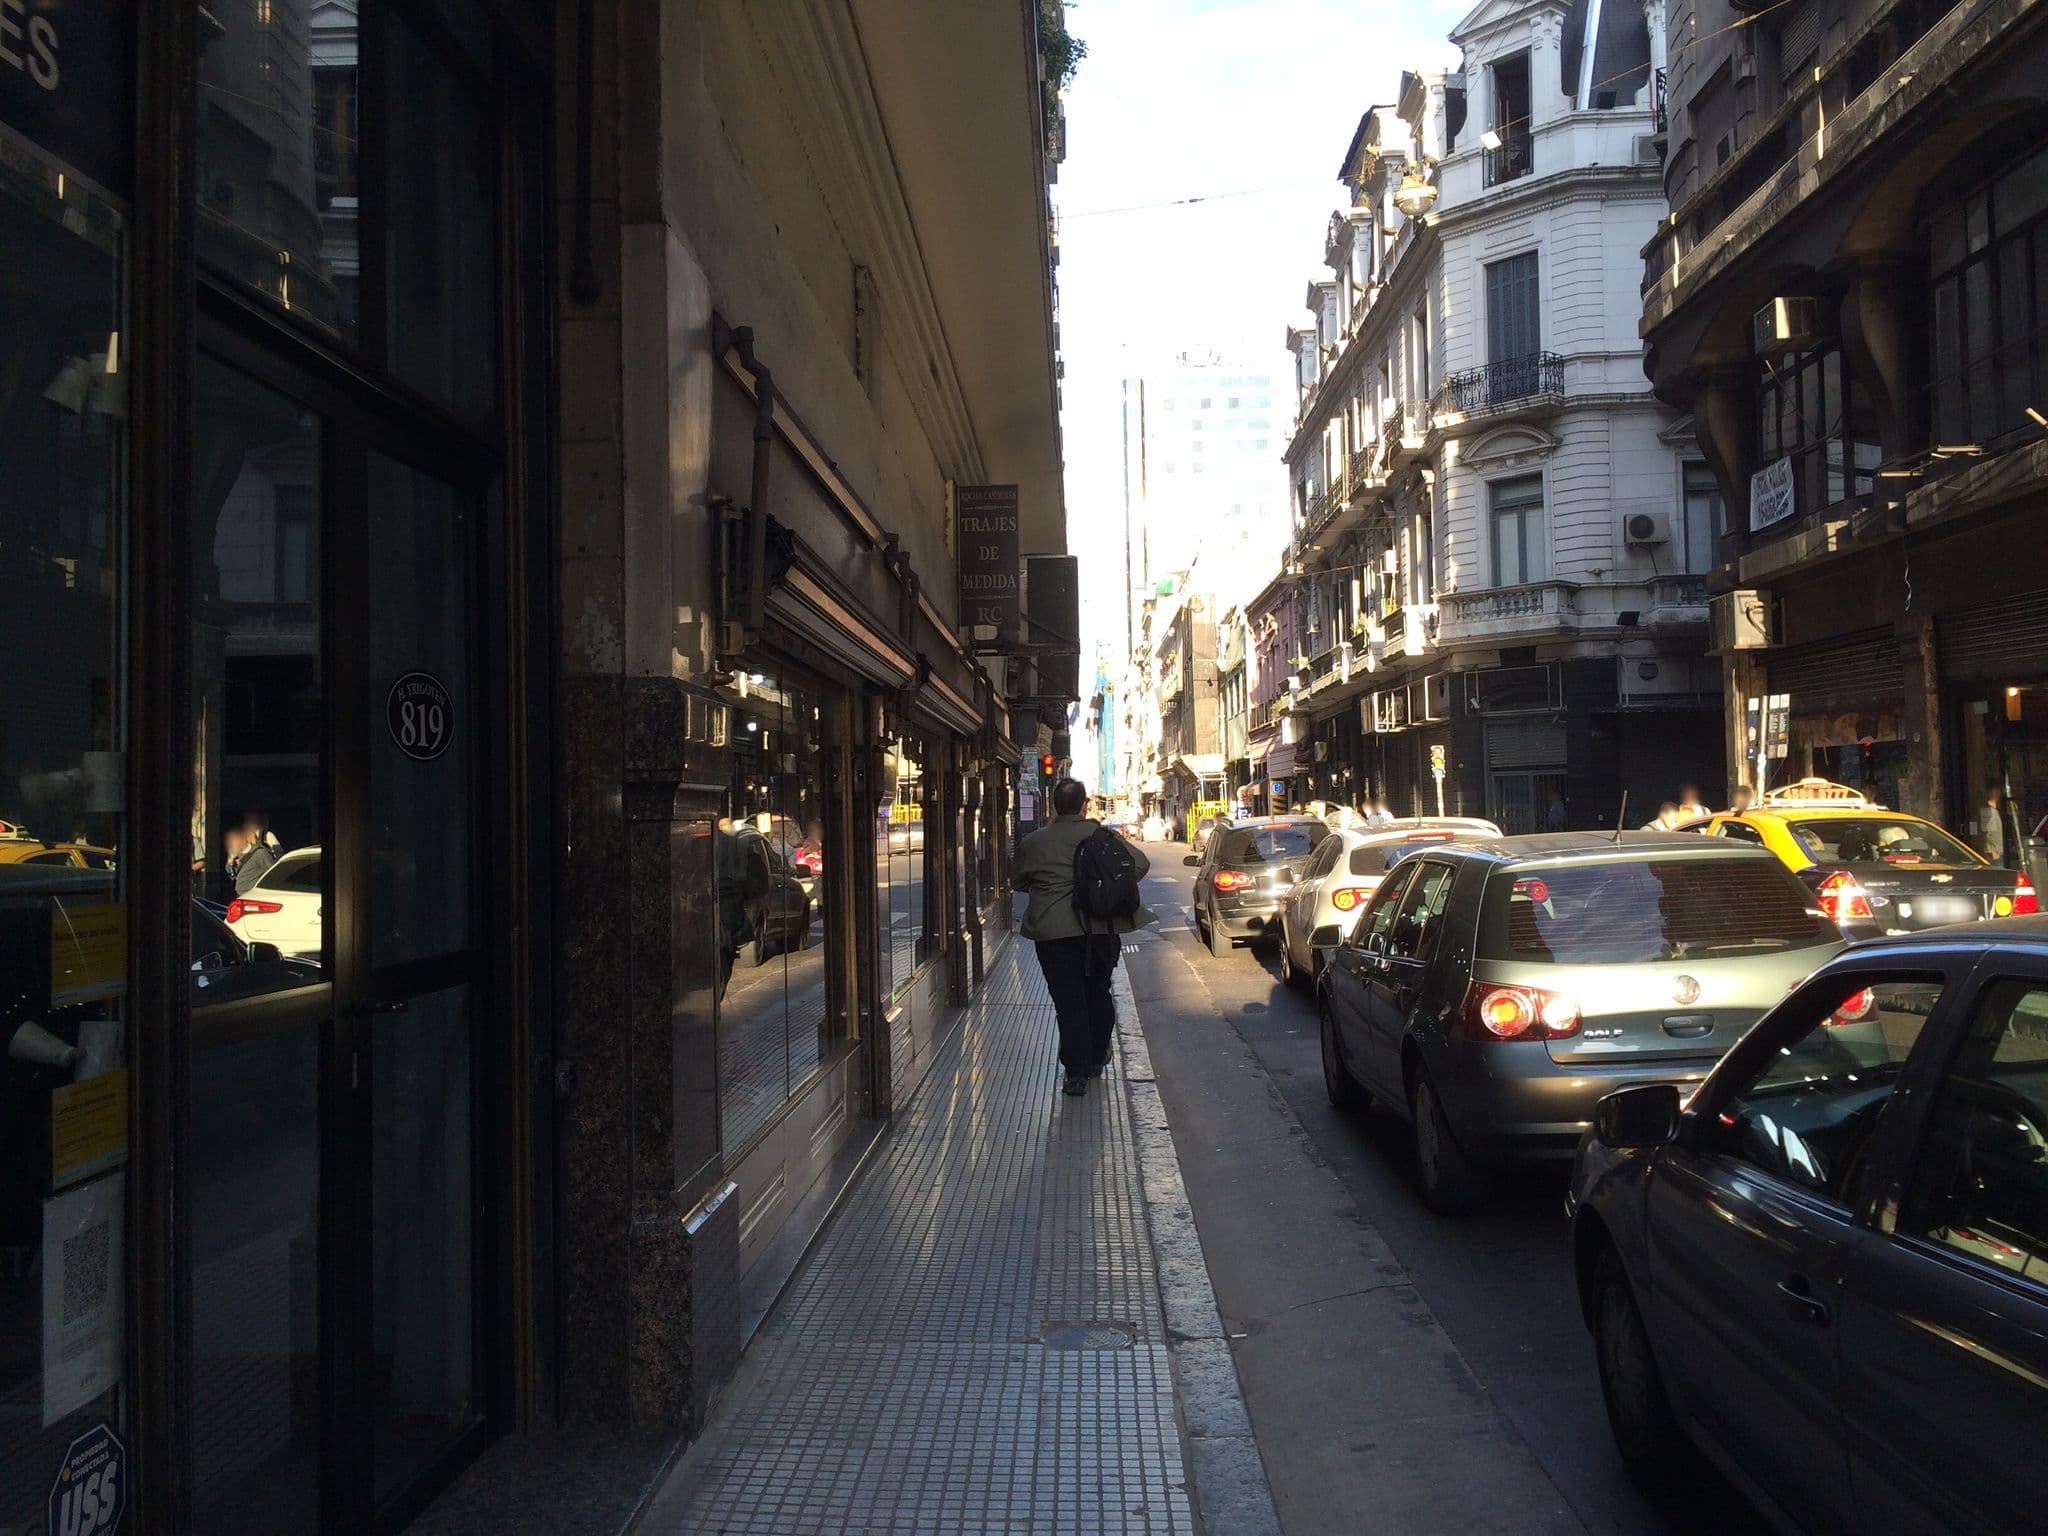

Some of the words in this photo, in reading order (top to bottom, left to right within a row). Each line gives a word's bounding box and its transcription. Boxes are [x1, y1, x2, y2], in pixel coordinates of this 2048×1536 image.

[961, 517, 1016, 532] TRAJES
[979, 546, 999, 560] DE
[962, 574, 1016, 589] MEDIDA
[401, 701, 443, 750] 819
[60, 1461, 118, 1536] USS
